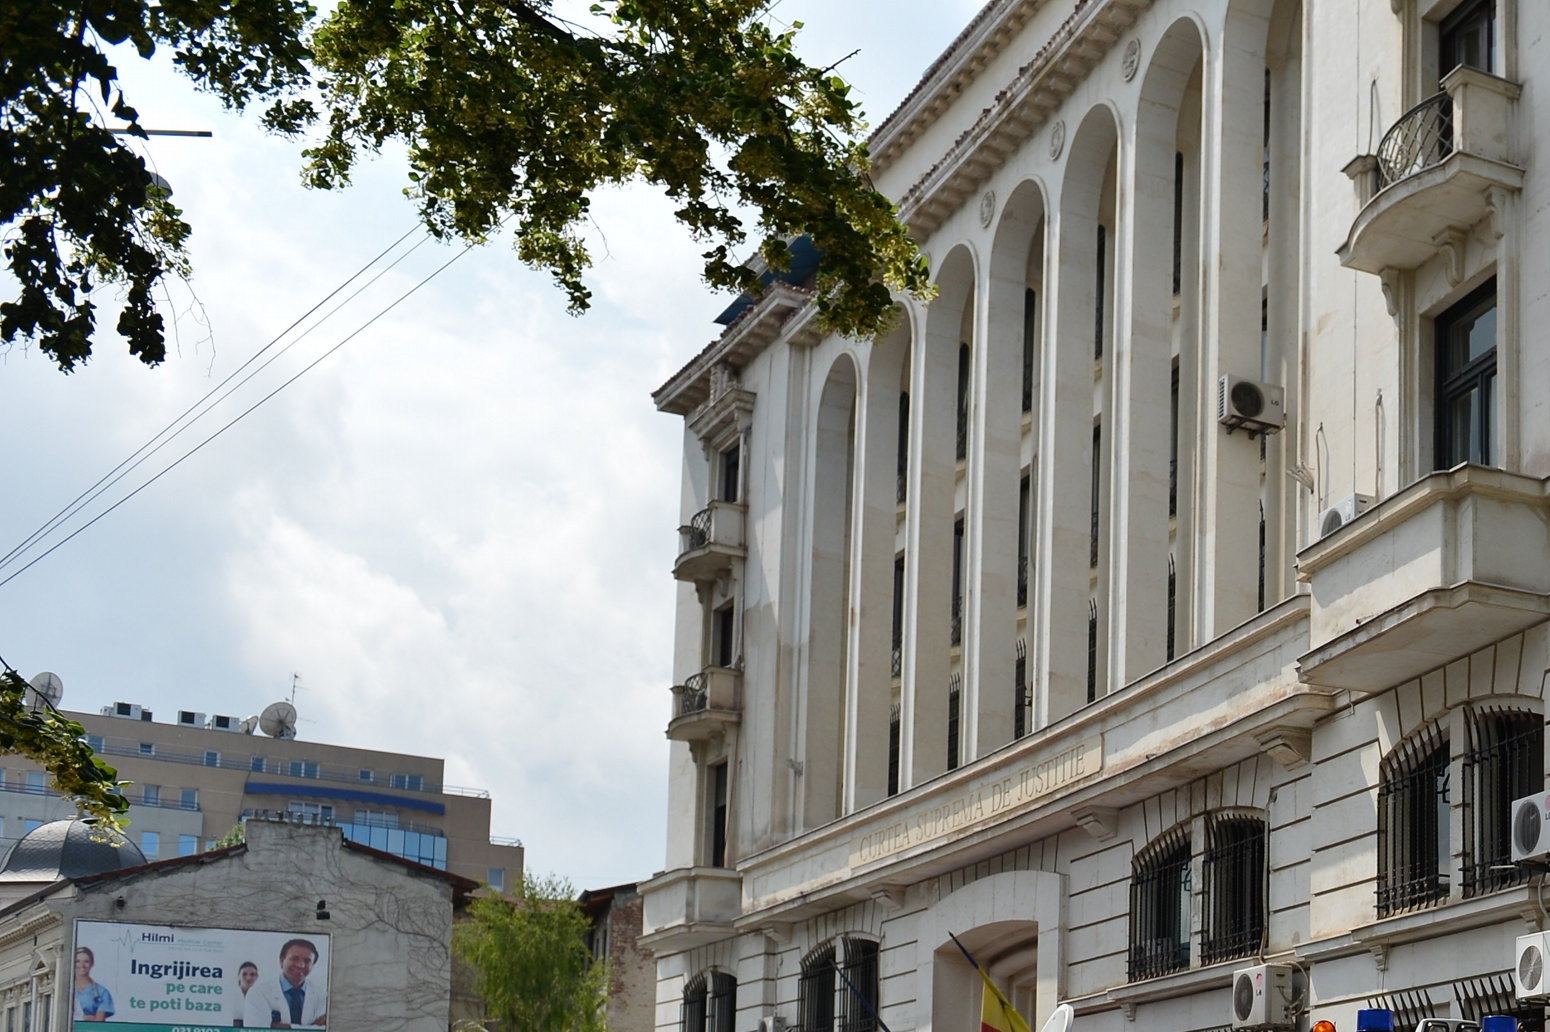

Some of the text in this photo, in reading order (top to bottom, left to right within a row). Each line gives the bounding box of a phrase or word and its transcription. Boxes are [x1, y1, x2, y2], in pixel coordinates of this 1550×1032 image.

[858, 744, 1085, 862] CURTEA SUPREMA DE JUSTITIE
[142, 932, 174, 943] Hilmi
[131, 959, 223, 980] Ingrijirea
[166, 983, 223, 995] pe care
[130, 997, 222, 1013] te poti baza
